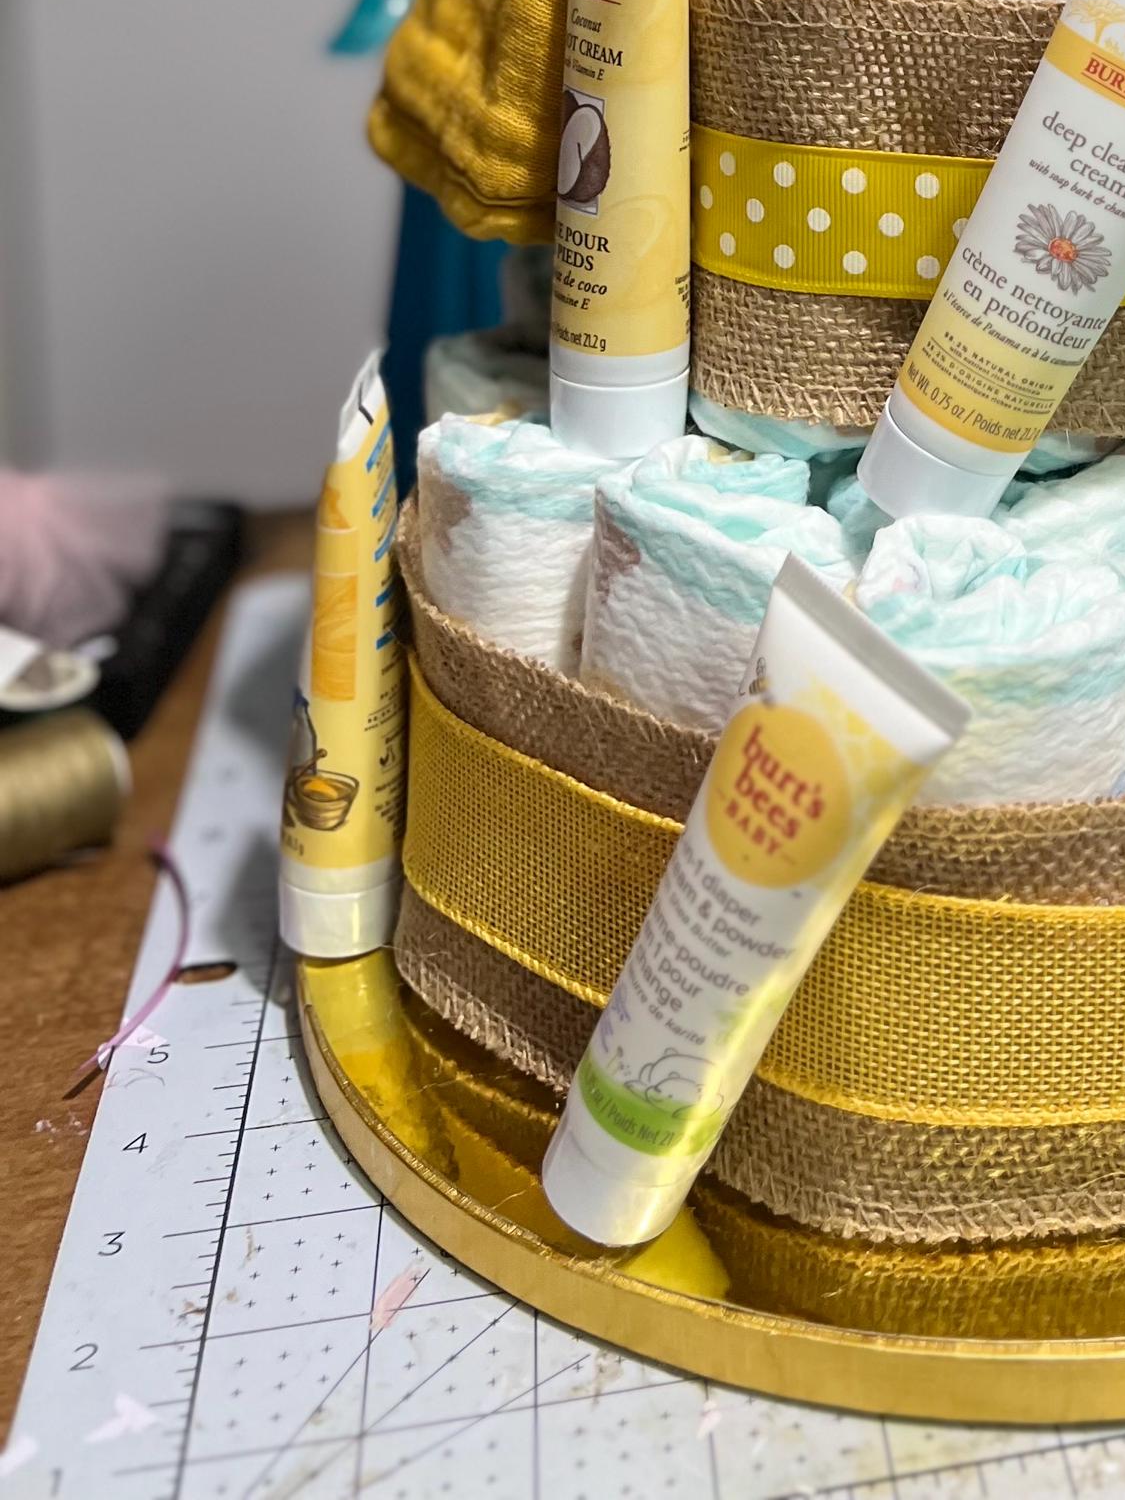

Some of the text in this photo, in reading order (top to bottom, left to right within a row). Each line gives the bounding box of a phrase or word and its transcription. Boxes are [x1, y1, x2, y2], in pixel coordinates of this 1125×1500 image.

[571, 8, 602, 33] Coconut
[579, 39, 623, 67] CREAM
[597, 68, 605, 80] E
[1042, 111, 1087, 153] deep
[1029, 159, 1049, 175] with
[1049, 172, 1069, 189] soap
[1070, 182, 1093, 200] bark
[1094, 196, 1105, 205] &
[557, 244, 594, 271] PIEDS
[566, 226, 611, 253] POUR
[564, 270, 575, 288] de
[578, 281, 607, 295] coco
[962, 247, 1106, 330] crème nettoyante
[581, 298, 591, 310] E
[964, 279, 1091, 350] en profondeur
[600, 338, 606, 352] g
[971, 316, 983, 327] de
[983, 323, 1021, 350] Panama
[1021, 346, 1031, 355] et
[1032, 349, 1039, 358] à
[1040, 351, 1050, 362] la
[949, 360, 999, 395] D'ORIGINE
[1004, 393, 1053, 409] NATURELLE
[972, 352, 1016, 380] NATURAL
[1021, 378, 1054, 391] ORIGIN
[907, 361, 919, 380] Net
[930, 387, 952, 410] 0.75
[951, 404, 966, 420] oz
[972, 411, 1001, 436] Poids
[1001, 426, 1021, 441] net
[742, 723, 825, 821] burt's
[734, 762, 801, 840] bees
[724, 797, 781, 856] BABY
[702, 874, 762, 926] diaper
[712, 917, 795, 960] powder
[658, 957, 703, 999] pour
[648, 1004, 664, 1021] de
[147, 1044, 170, 1064] 5
[608, 1102, 638, 1135] Poids
[122, 1132, 148, 1154] 4
[98, 1231, 125, 1256] 3
[69, 1343, 98, 1371] 2
